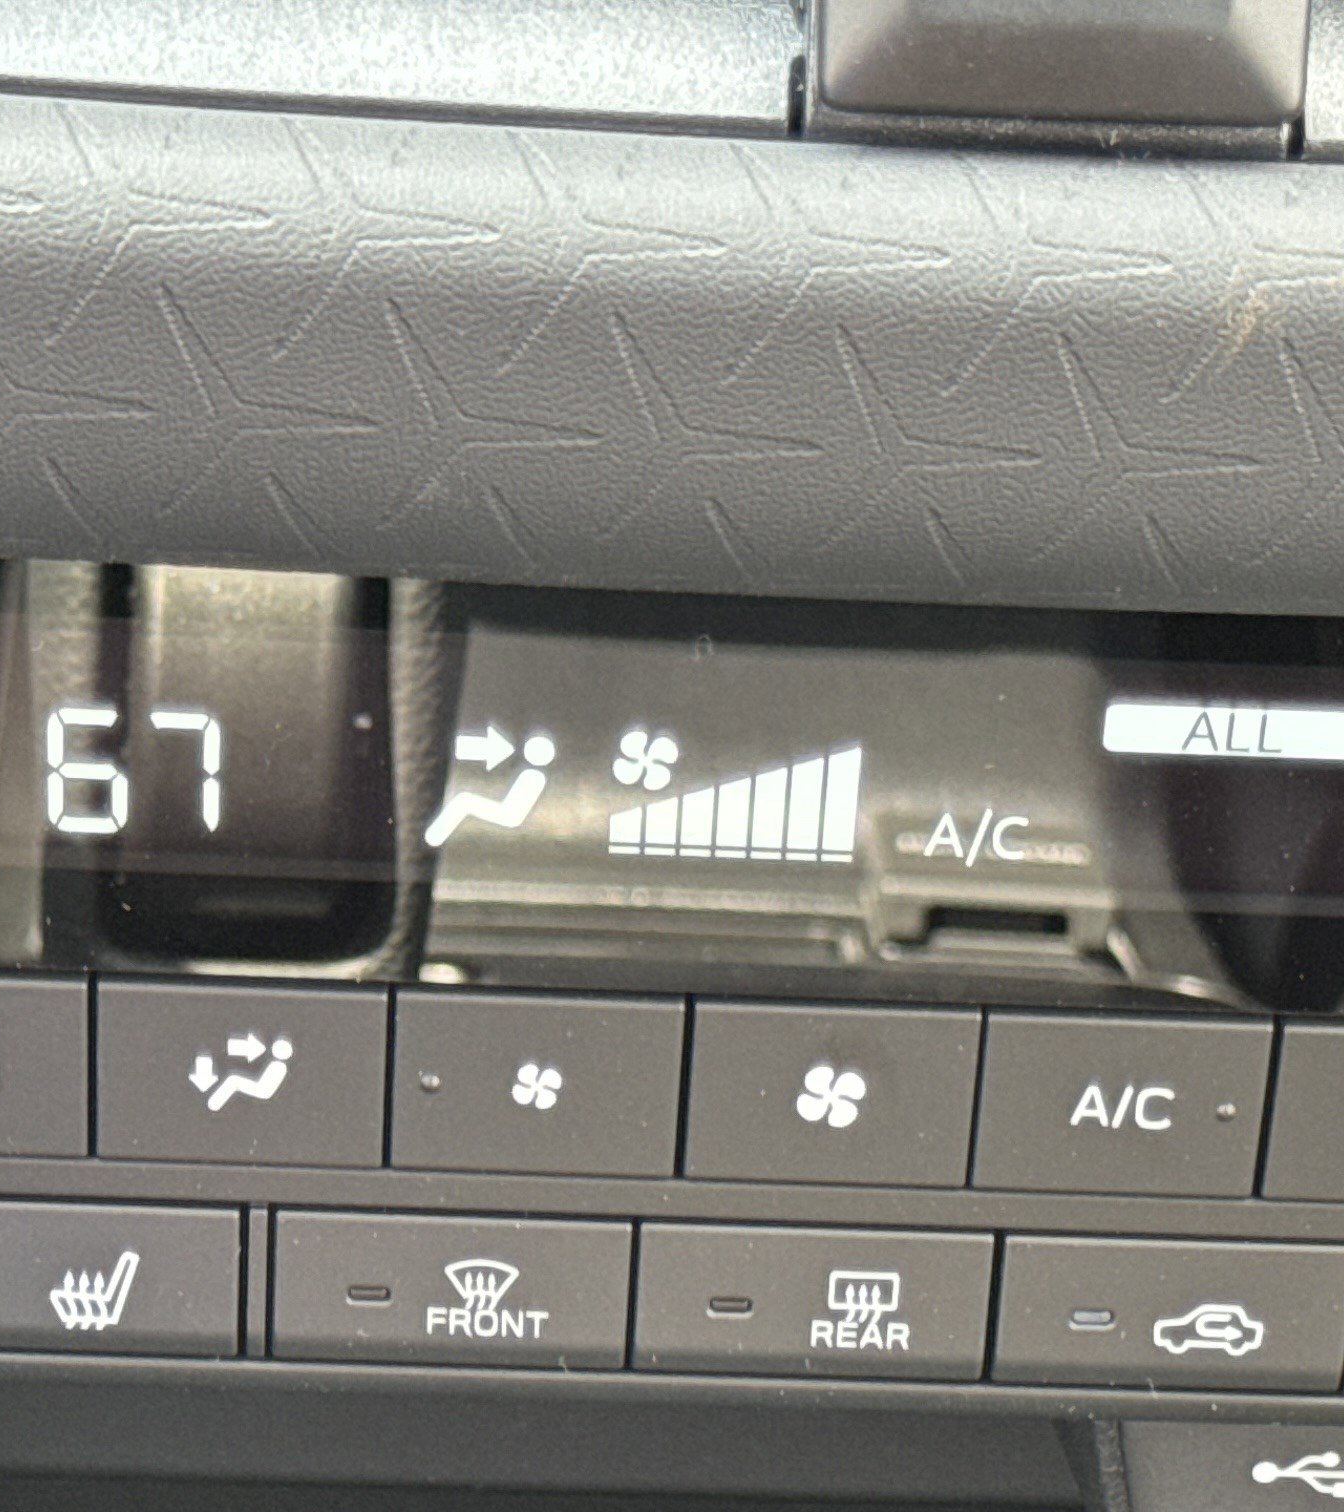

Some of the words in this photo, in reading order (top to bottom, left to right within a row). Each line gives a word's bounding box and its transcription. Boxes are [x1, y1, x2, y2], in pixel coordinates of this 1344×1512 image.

[1182, 711, 1283, 755] ALL
[46, 707, 220, 834] 67
[923, 808, 1029, 868] A/C
[1069, 1083, 1176, 1131] A/C
[425, 1305, 550, 1340] FRONT
[810, 1320, 911, 1352] REAR
